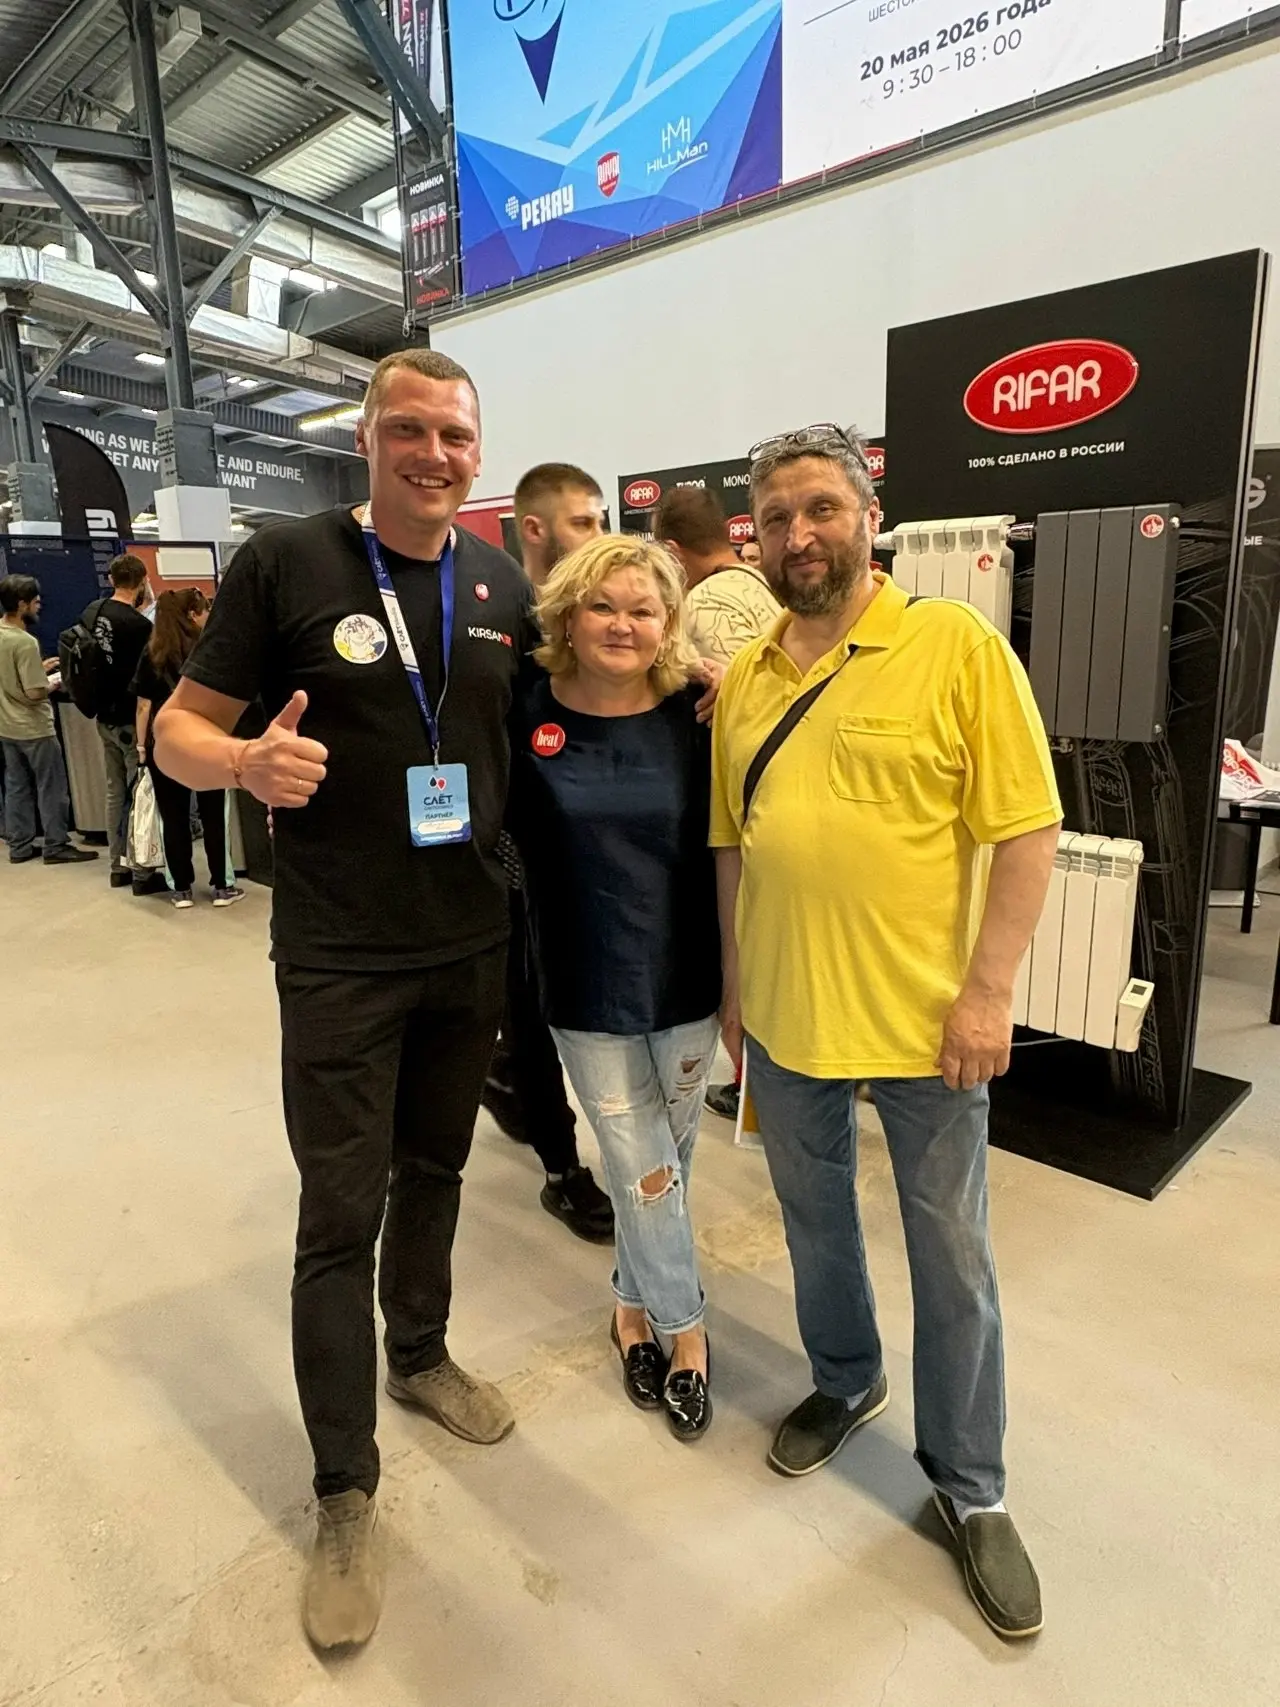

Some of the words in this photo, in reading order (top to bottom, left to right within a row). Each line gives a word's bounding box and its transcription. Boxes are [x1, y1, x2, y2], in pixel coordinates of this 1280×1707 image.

[860, 56, 884, 81] 20
[890, 40, 930, 69] мая
[936, 11, 990, 50] 2026
[409, 173, 444, 196] НОВИНКА
[521, 184, 574, 231] РЕХАУ
[993, 359, 1103, 415] RIFAR
[107, 433, 127, 450] AS
[129, 437, 150, 454] WE
[968, 457, 995, 469] 100%
[998, 449, 1056, 467] СДЕЛАНО
[1059, 448, 1068, 458] В
[1071, 441, 1125, 457] РОССИИ
[221, 471, 257, 490] WANT
[227, 456, 253, 473] AND
[256, 460, 304, 484] ENDURE,
[630, 486, 654, 501] RIFAR
[536, 729, 560, 747] heat
